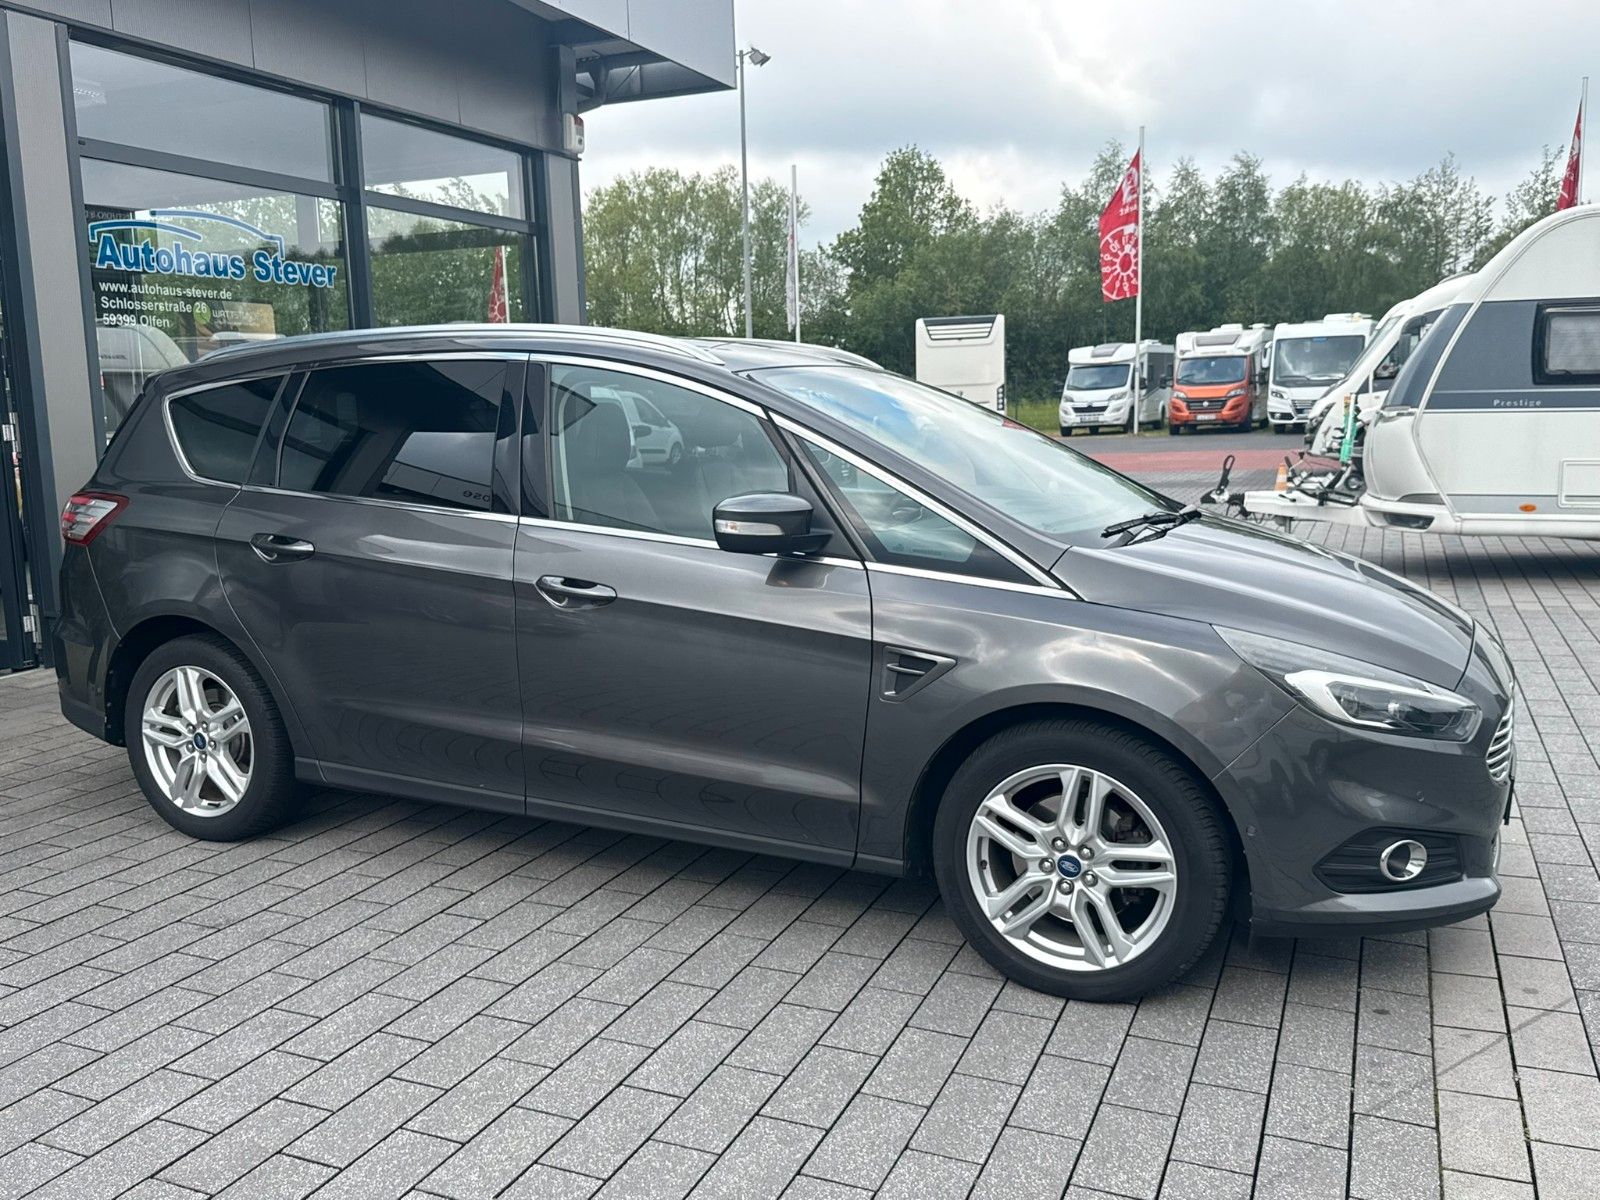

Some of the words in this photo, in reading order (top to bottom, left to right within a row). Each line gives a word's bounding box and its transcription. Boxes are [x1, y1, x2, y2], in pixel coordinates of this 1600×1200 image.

[96, 234, 246, 280] Autohaus
[253, 251, 337, 288] Stever
[99, 282, 232, 300] www.autohaus-stever.de
[101, 296, 192, 313] Schlosserstraße
[195, 302, 208, 314] 26
[103, 313, 136, 326] 59399
[140, 315, 170, 328] Olfen
[1493, 399, 1542, 407] Prestige
